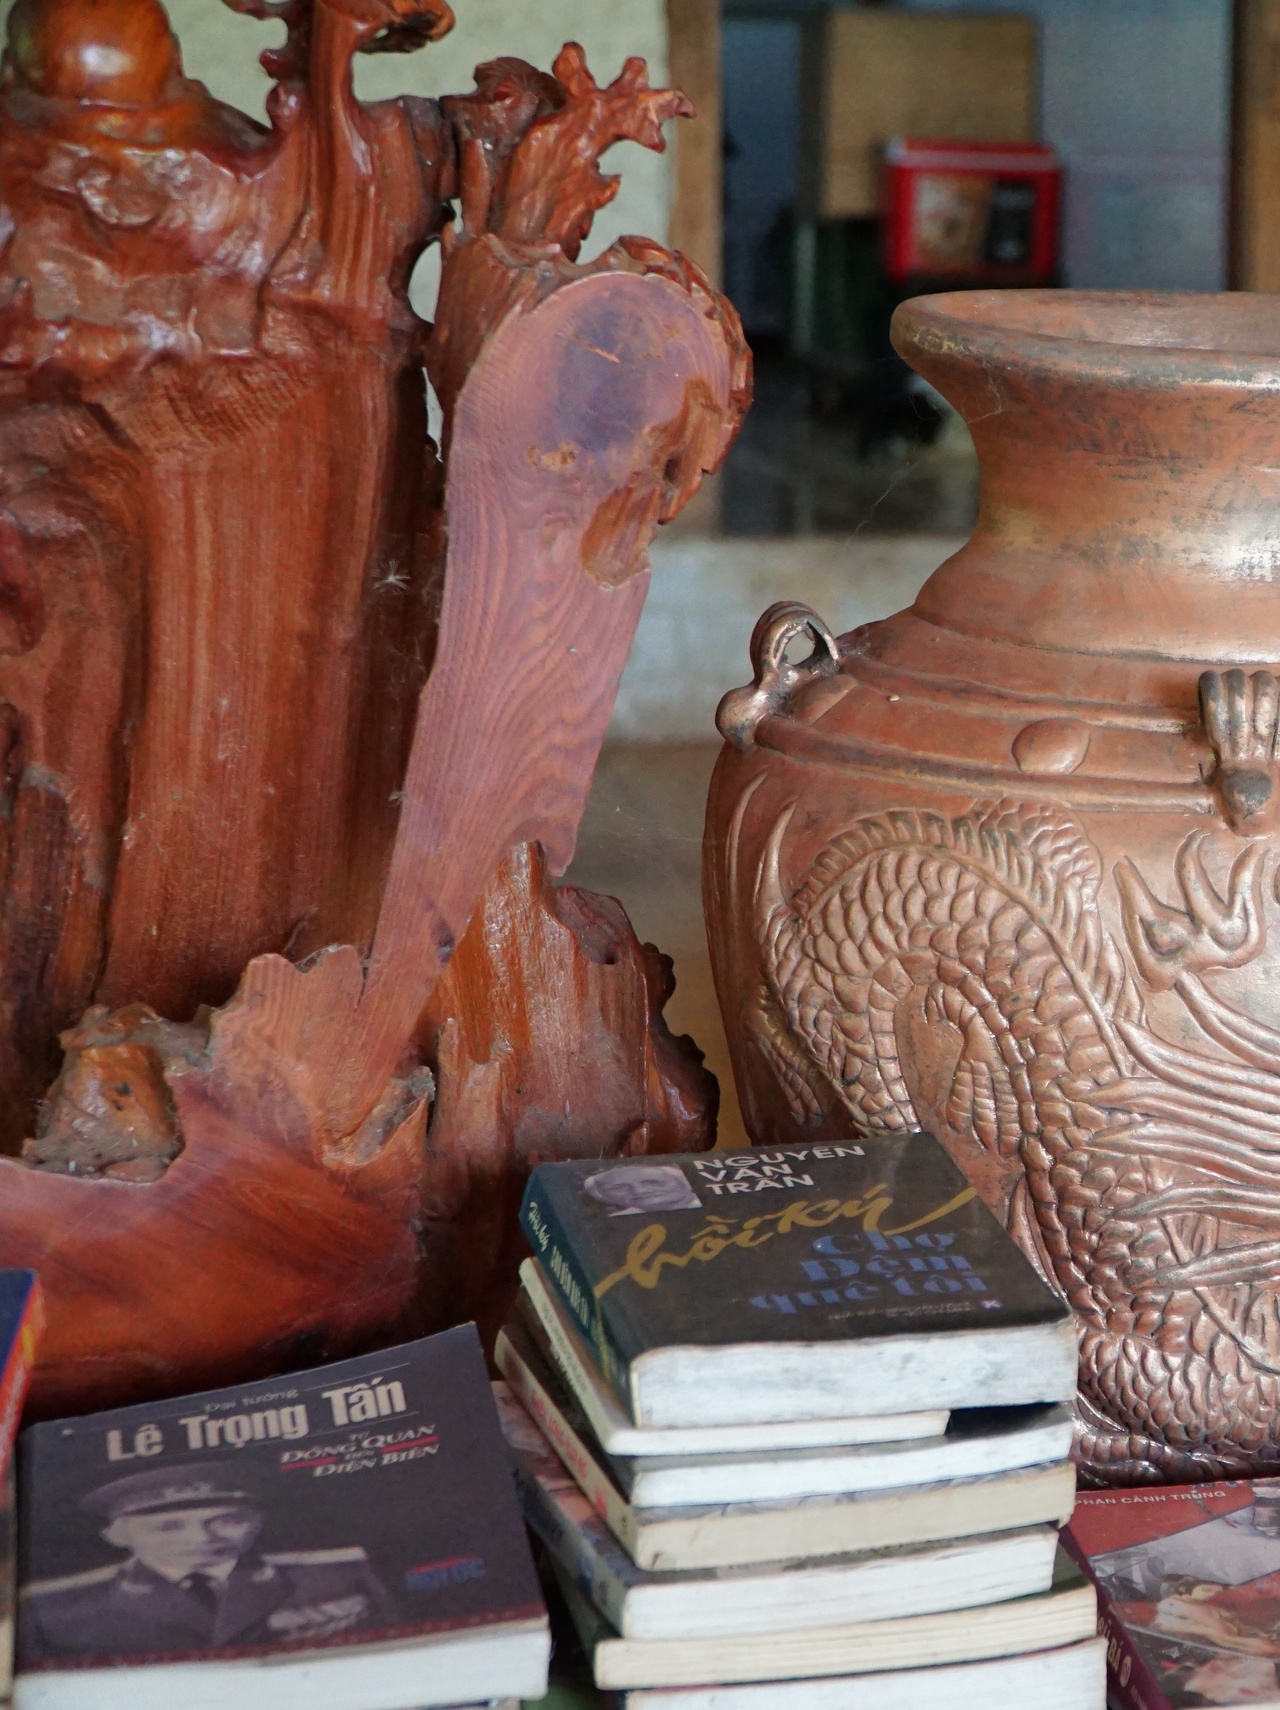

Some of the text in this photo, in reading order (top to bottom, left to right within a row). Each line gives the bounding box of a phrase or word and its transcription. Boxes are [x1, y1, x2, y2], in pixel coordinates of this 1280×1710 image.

[692, 1144, 866, 1170] NGUYỄN
[698, 1163, 794, 1183] VĂN
[705, 1174, 815, 1196] TRẤN
[107, 1376, 407, 1462] Lê Trọng Tấn
